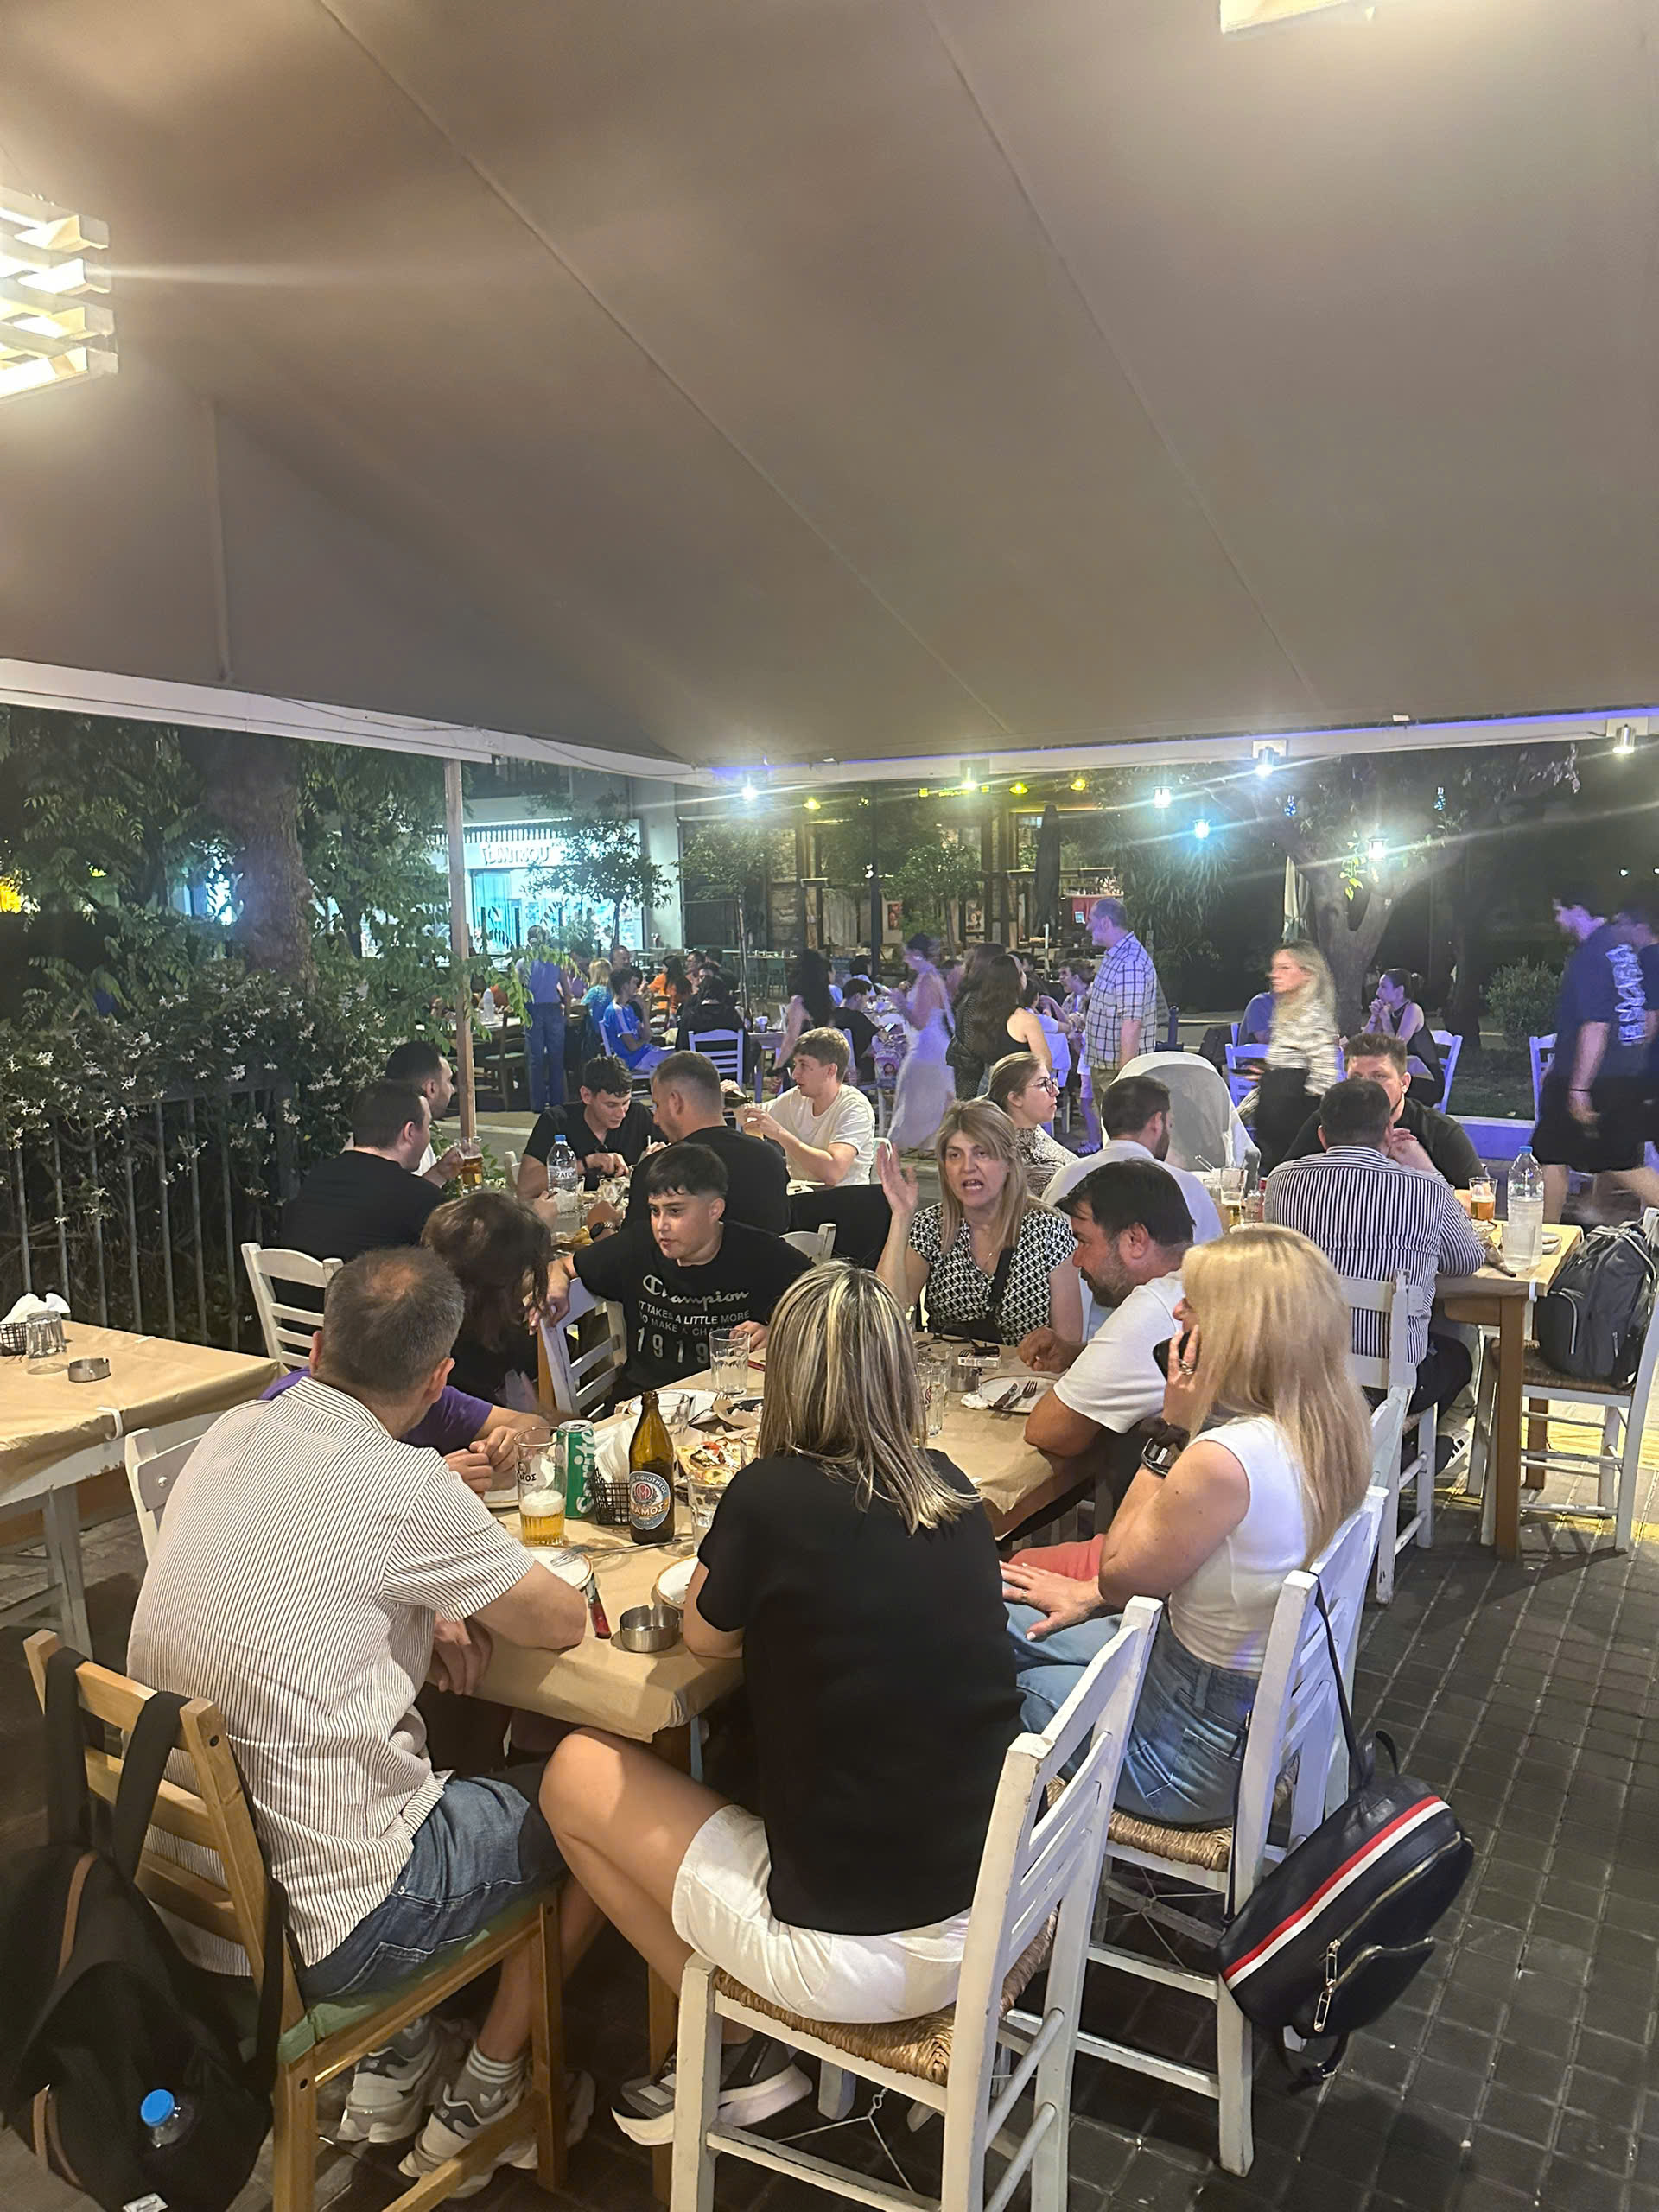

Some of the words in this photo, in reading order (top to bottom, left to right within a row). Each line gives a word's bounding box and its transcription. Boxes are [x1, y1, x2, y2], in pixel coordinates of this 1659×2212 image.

[643, 1274, 749, 1312] Champion
[647, 1303, 673, 1321] TAKES
[675, 1314, 682, 1324] A
[683, 1315, 719, 1325] LITTLE
[721, 1310, 750, 1323] MORE
[651, 1318, 677, 1332] MAKE
